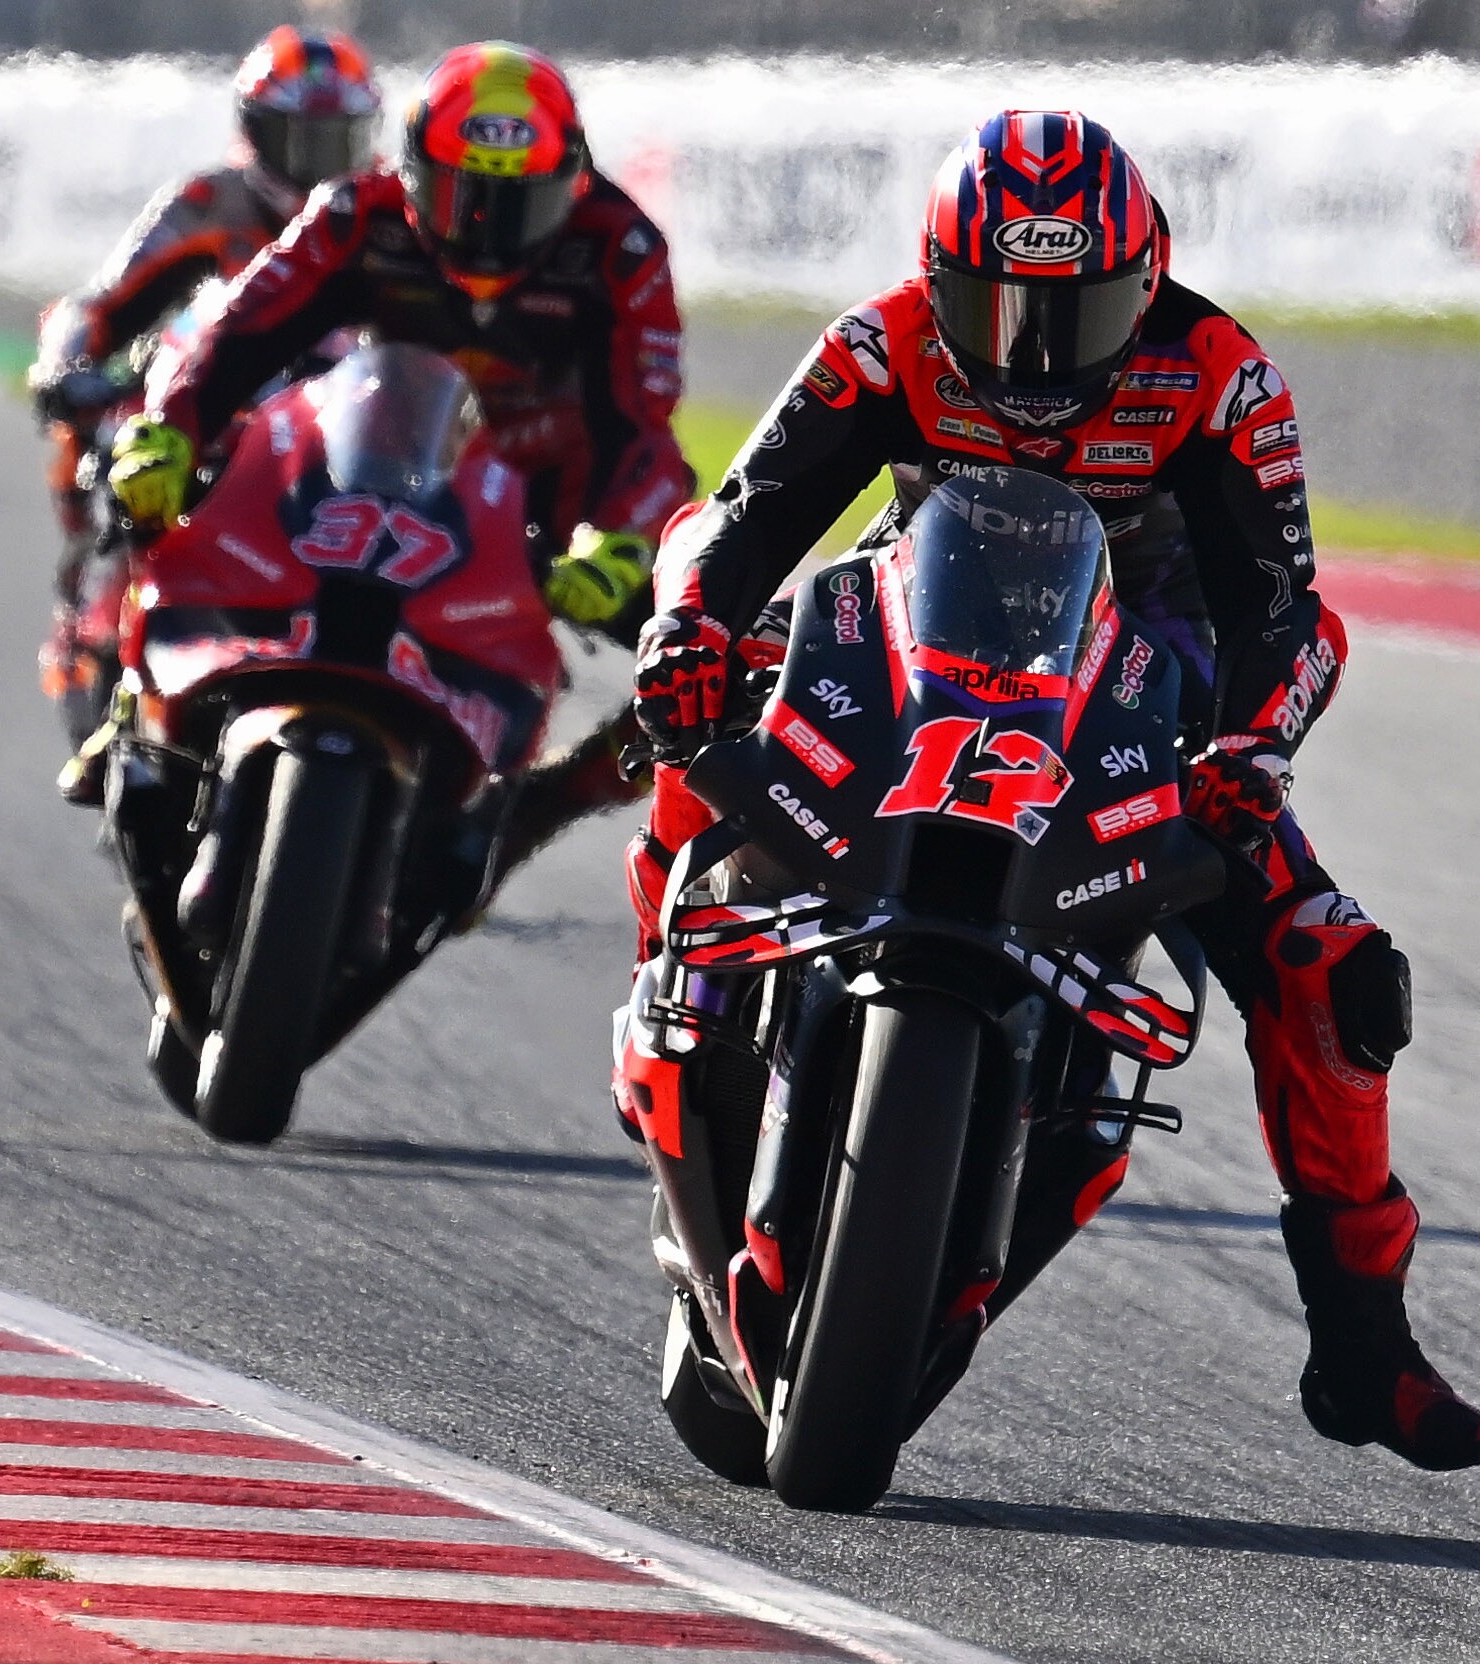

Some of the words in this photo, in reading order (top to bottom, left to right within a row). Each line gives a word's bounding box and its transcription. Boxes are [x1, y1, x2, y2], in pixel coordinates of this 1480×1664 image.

[1001, 221, 1079, 248] Arai
[1004, 395, 1074, 408] MAVERICK
[1113, 411, 1156, 423] CASE
[290, 493, 464, 589] 37
[808, 678, 863, 719] sky
[942, 666, 1040, 700] aprilia
[1272, 637, 1337, 741] aprilia
[784, 719, 847, 773] BS
[1100, 743, 1150, 778] sky
[873, 715, 1076, 847] 12
[768, 783, 830, 841] CASE
[1094, 795, 1159, 833] BS
[1056, 870, 1122, 910] CASE
